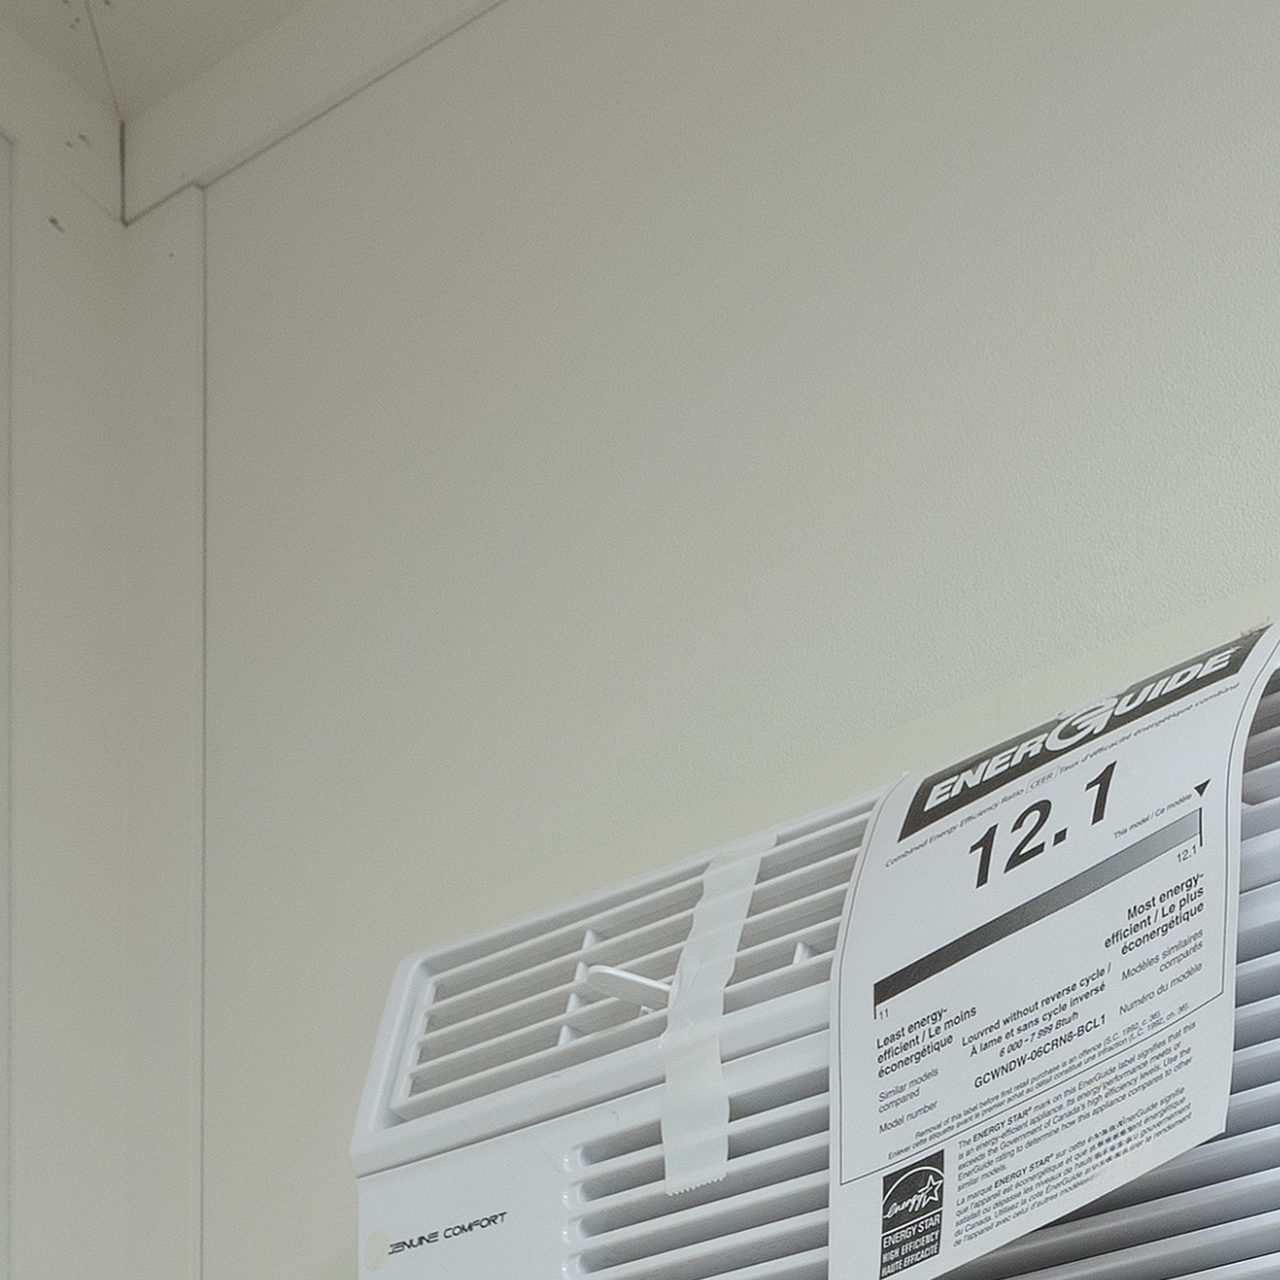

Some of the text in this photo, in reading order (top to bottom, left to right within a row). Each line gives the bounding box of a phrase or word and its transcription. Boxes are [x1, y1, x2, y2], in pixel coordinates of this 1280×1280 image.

[968, 760, 1118, 890] 12.1
[1114, 827, 1128, 839] This
[1129, 816, 1150, 832] model
[1176, 845, 1197, 863] 12.1
[1105, 915, 1151, 947] efficient
[1162, 903, 1175, 917] Le
[1179, 886, 1204, 909] plus
[1127, 873, 1204, 920] Most energy-
[1121, 902, 1204, 955] éconergétique
[1121, 928, 1204, 981] Modèles similaires
[1159, 939, 1203, 972] comparés
[962, 1019, 1001, 1047] Louvred
[1002, 1001, 1039, 1025] without
[1041, 982, 1077, 1008] reverse
[1080, 967, 1105, 987] cycle
[1119, 962, 1202, 1015] Numéro du modèle
[877, 1008, 947, 1049] Least energy-
[877, 1034, 920, 1064] efficient
[928, 1025, 941, 1039] Le
[943, 1007, 976, 1031] moins
[970, 981, 1106, 1057] À lame et sans cycle inversé
[878, 1034, 953, 1078] éconergétique
[878, 1067, 939, 1102] Similar models
[878, 1087, 920, 1113] compared
[958, 1138, 971, 1149] The
[973, 1120, 1005, 1142] ENERGY
[1033, 1099, 1050, 1113] mark
[1053, 1094, 1062, 1103] on
[1063, 1086, 1076, 1097] this
[1078, 1066, 1116, 1090] EnerGuide
[1118, 1054, 1135, 1070] label
[1168, 1029, 1181, 1043] that
[1183, 1022, 1195, 1034] this
[965, 1148, 974, 1157] an
[1173, 1041, 1180, 1051] or
[987, 1146, 998, 1156] the
[1000, 1124, 1042, 1150] Government
[1044, 1118, 1050, 1129] of
[1087, 1095, 1102, 1107] high
[1163, 1055, 1177, 1067] Use
[1180, 1047, 1191, 1058] the
[879, 1100, 938, 1134] Model number
[958, 1160, 993, 1181] EnerGuide
[1016, 1145, 1023, 1153] to
[1061, 1119, 1075, 1131] how
[1078, 1112, 1090, 1123] this
[1165, 1069, 1172, 1077] to
[957, 1198, 965, 1207] La
[994, 1166, 1027, 1189] ENERGY
[443, 1211, 507, 1239] COMFORT
[882, 1230, 940, 1264] HIGH EFFICIENCY
[883, 1213, 940, 1249] ENERGY STAR
[881, 1260, 903, 1278] HAUTE
